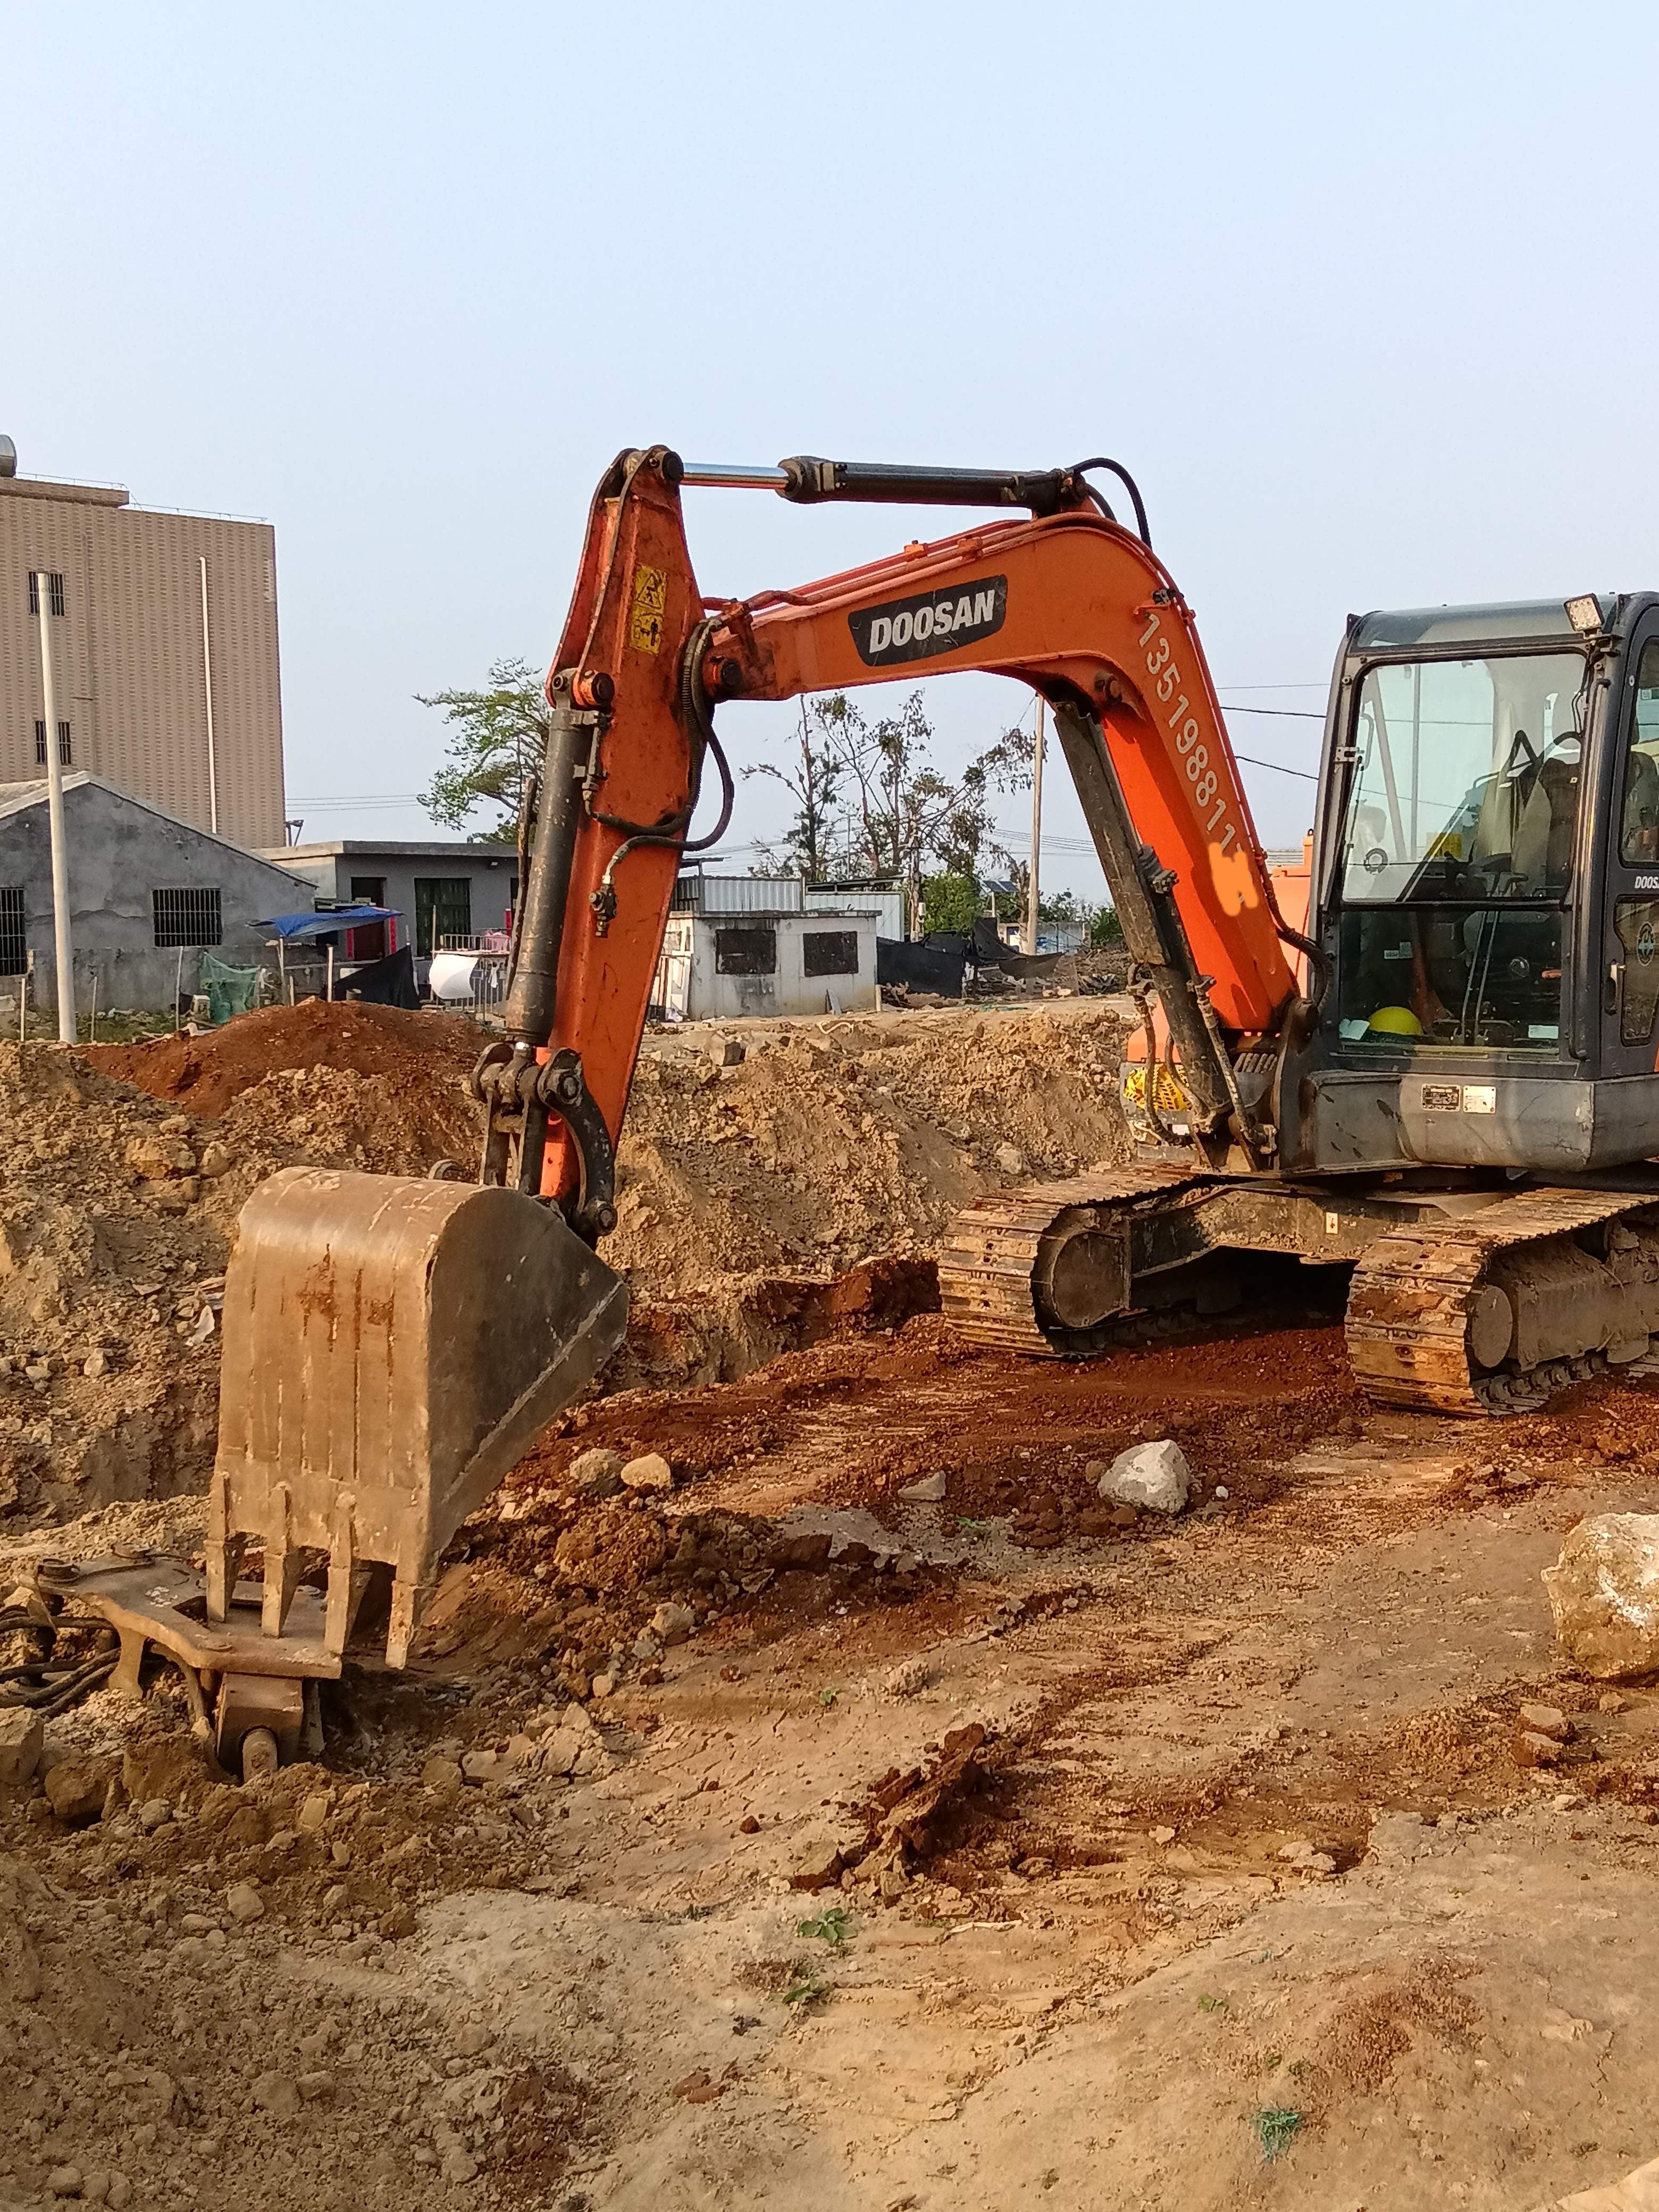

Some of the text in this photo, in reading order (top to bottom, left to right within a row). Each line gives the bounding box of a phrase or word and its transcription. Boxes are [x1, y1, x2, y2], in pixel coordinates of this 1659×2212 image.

[869, 589, 995, 653] DOOSAN
[1139, 614, 1253, 903] 135198811
[1635, 876, 1659, 889] DOOS
